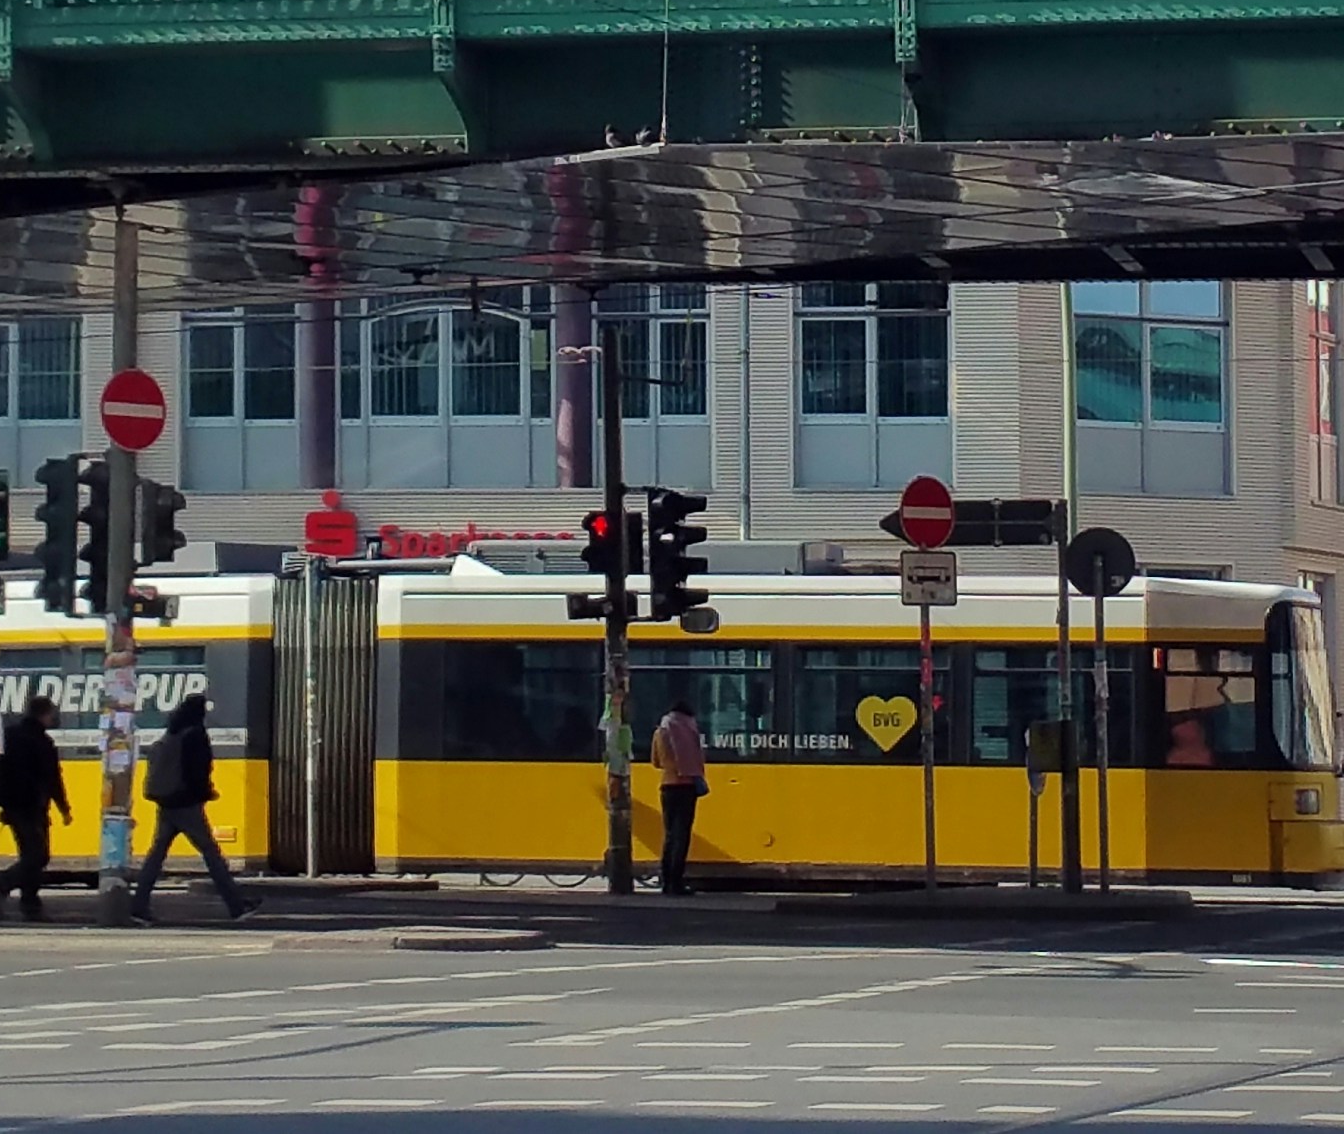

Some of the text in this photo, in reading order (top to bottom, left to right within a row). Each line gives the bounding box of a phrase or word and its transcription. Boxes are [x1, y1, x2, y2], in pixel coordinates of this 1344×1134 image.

[379, 521, 575, 558] Spark
[873, 713, 901, 727] BVG
[714, 734, 744, 748] WIR
[751, 734, 788, 749] DICH
